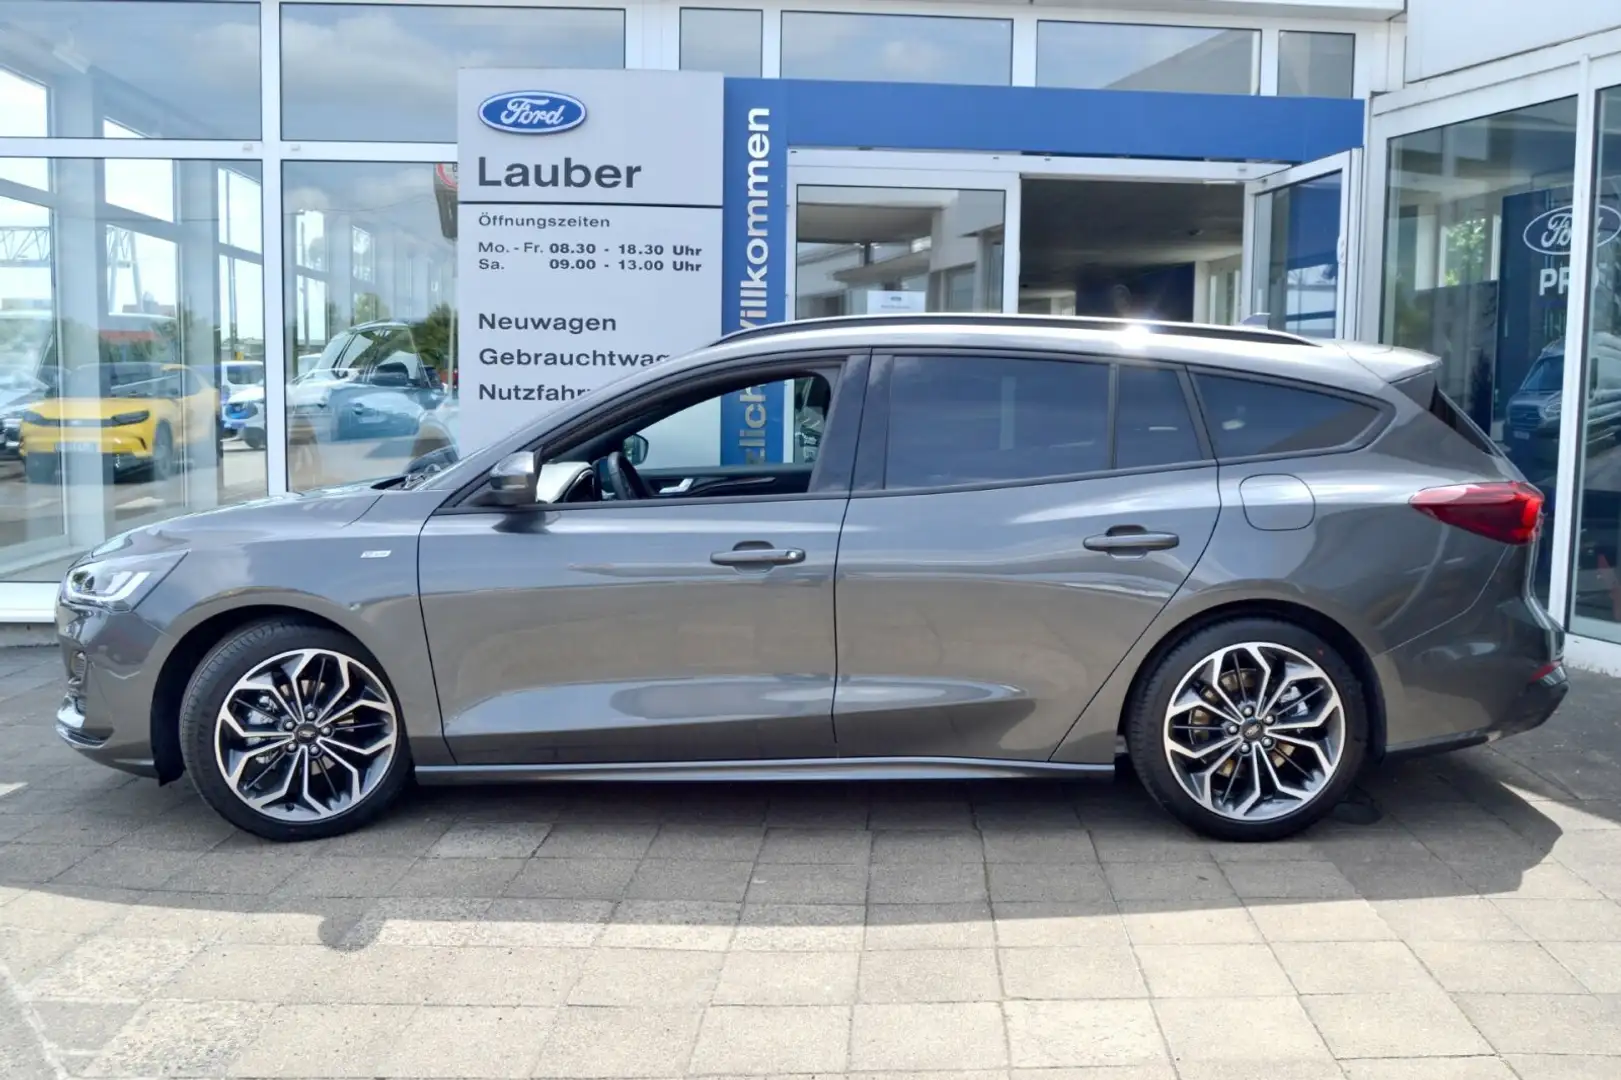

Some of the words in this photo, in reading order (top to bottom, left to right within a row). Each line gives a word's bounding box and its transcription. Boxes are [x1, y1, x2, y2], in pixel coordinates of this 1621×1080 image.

[500, 98, 566, 125] Ford
[478, 156, 642, 189] Lauber
[478, 211, 611, 231] Öffnungszeiten
[478, 241, 510, 254] Mo.
[523, 241, 544, 254] Fr.
[548, 242, 597, 255] 08.30
[618, 243, 665, 256] 18.30
[672, 244, 703, 257] Uhr
[478, 258, 505, 271] Sa.
[549, 258, 597, 271] 09.00
[618, 259, 665, 272] 13.00
[672, 260, 703, 272] Uhr
[478, 312, 617, 335] Neuwagen
[478, 384, 591, 401] Nutzfahr
